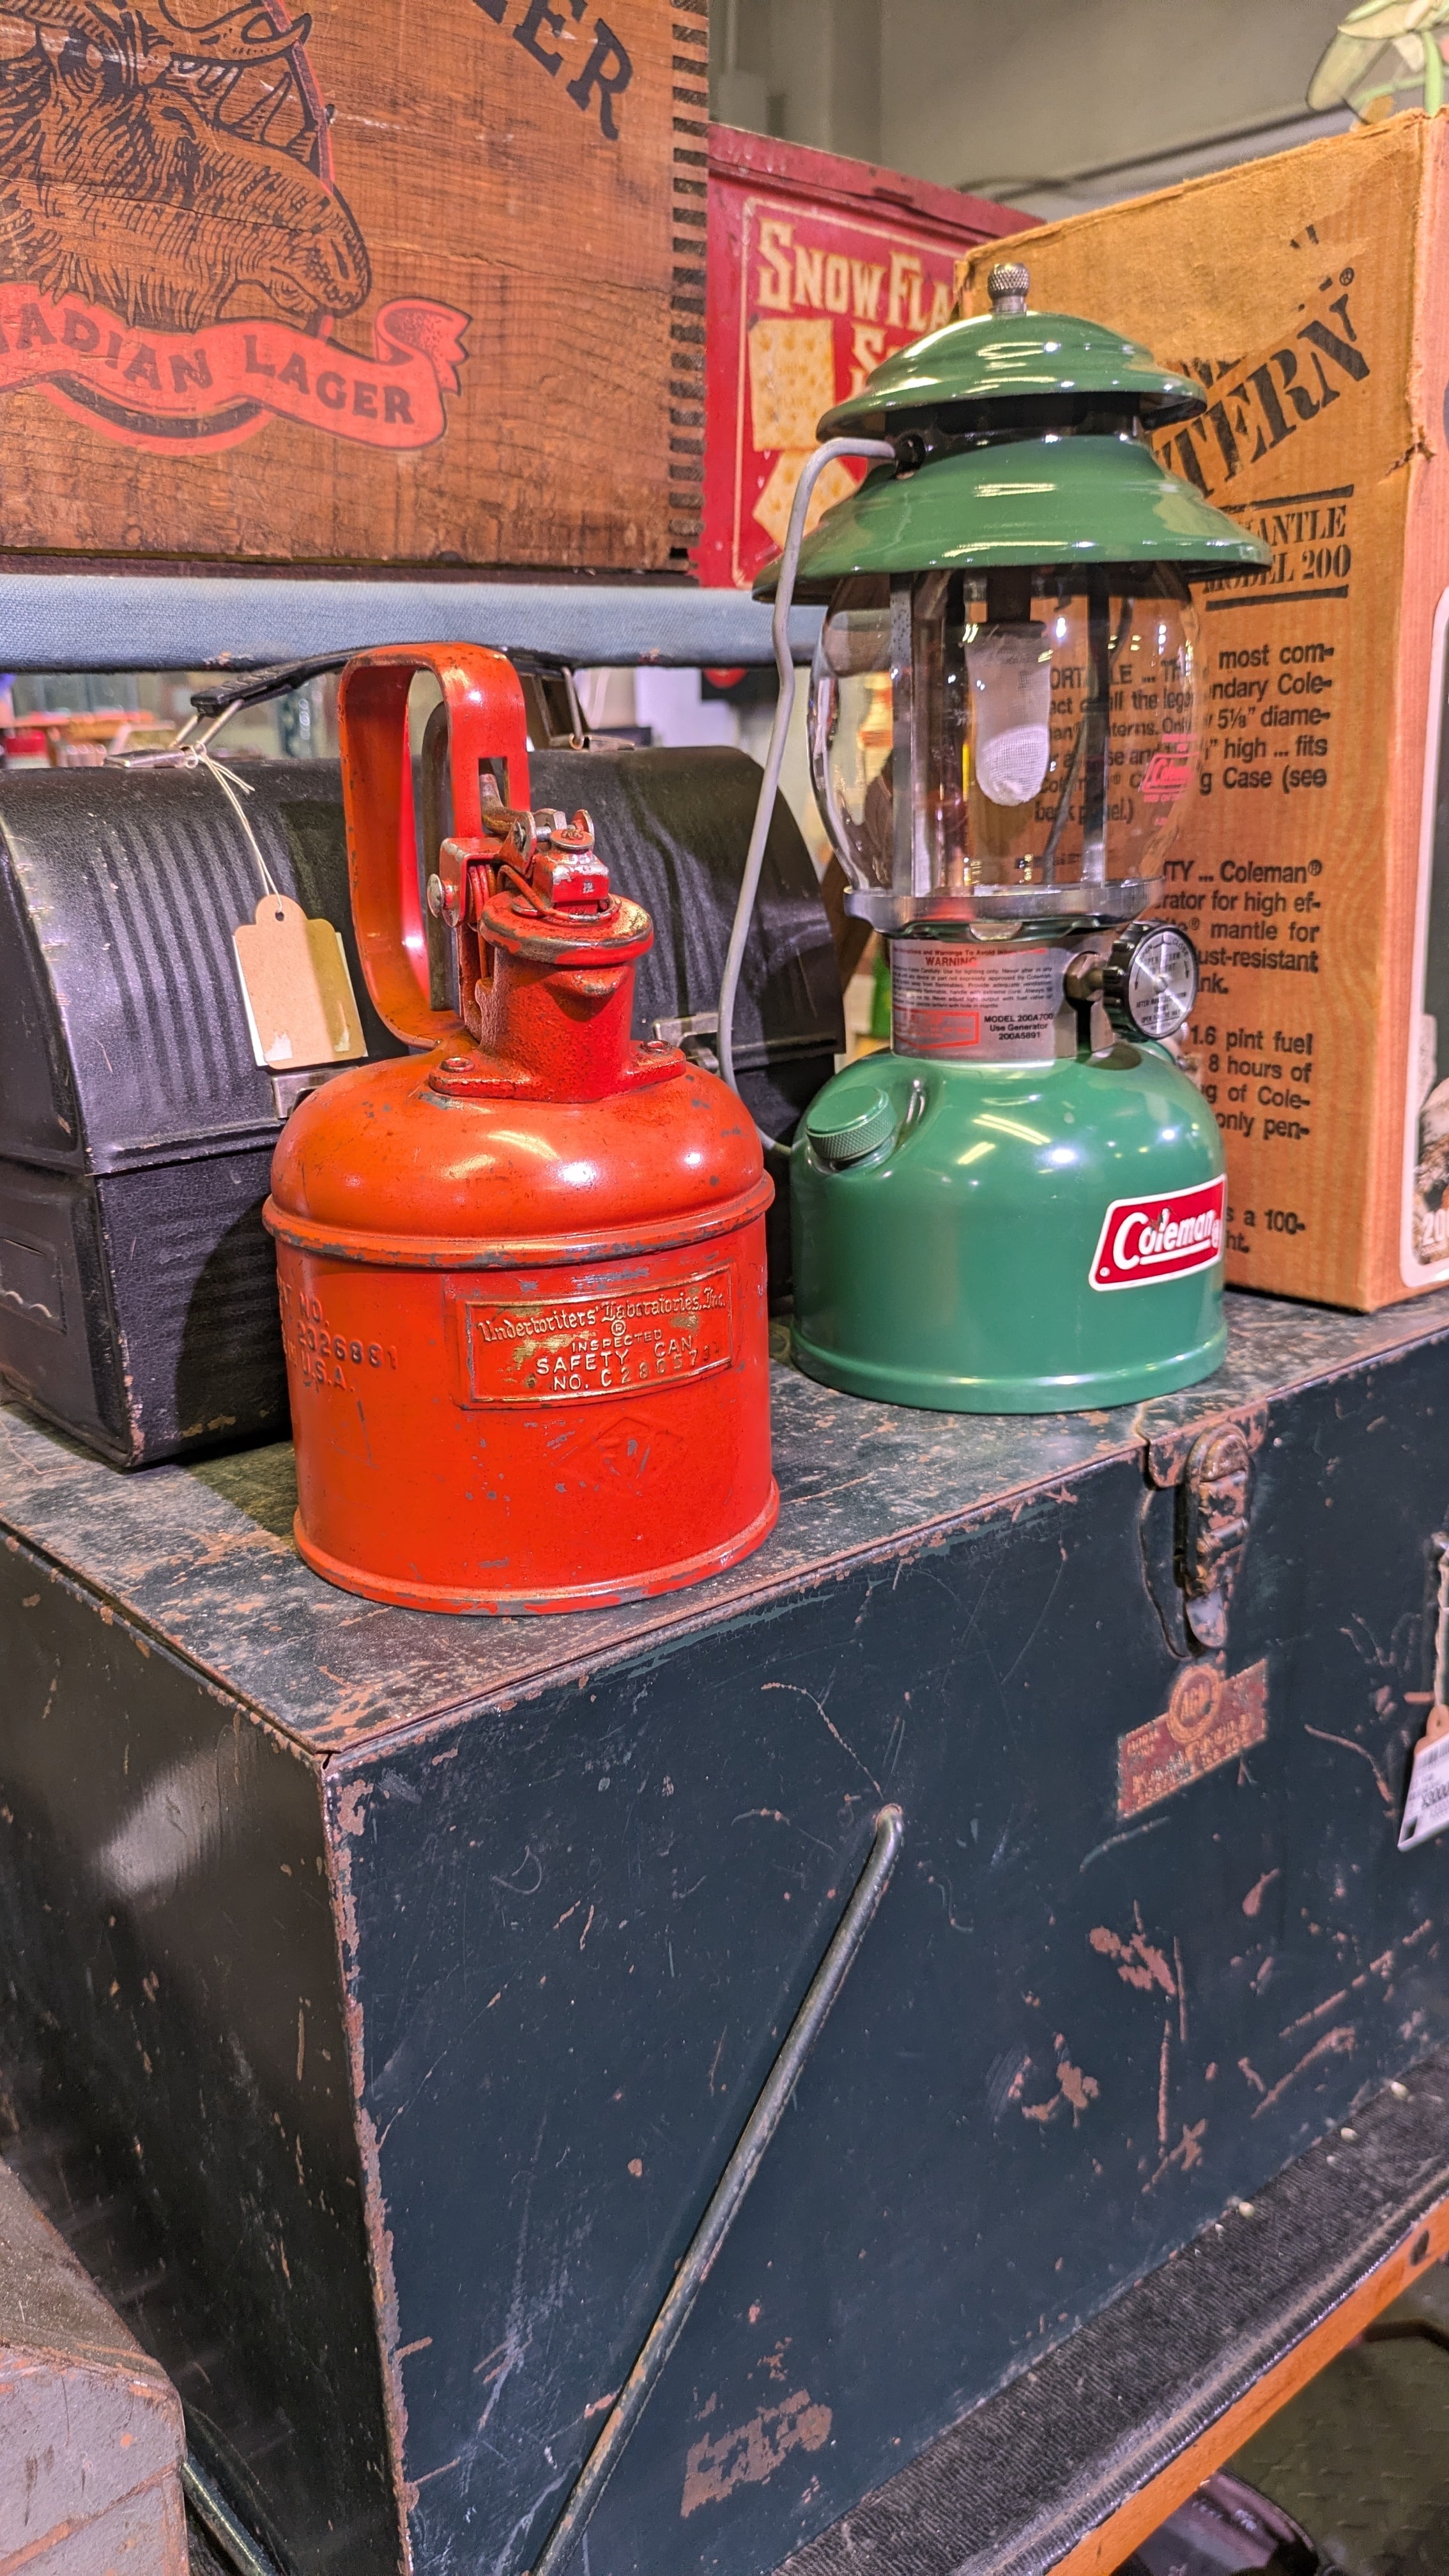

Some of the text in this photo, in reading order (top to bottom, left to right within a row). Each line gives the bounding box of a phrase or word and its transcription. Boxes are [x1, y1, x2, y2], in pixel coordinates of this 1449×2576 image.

[473, 0, 632, 141] ER
[756, 218, 956, 334] SNOW FLA
[0, 301, 415, 425] ADIAN LAGER
[1154, 293, 1371, 498] TERN
[1246, 504, 1346, 547] ANTLE
[1301, 544, 1352, 580] 200
[1218, 644, 1269, 670] most
[1279, 643, 1335, 665] com-
[1278, 671, 1333, 695] Cole-
[1261, 704, 1331, 728] diame-
[1223, 737, 1267, 763] high
[1295, 734, 1328, 757] fits
[1222, 767, 1272, 790] Case
[1282, 764, 1327, 795] (see
[1211, 889, 1238, 911] for
[1243, 892, 1287, 917] high
[1293, 891, 1321, 913] ef-
[1209, 921, 1278, 940] mantle
[1288, 921, 1321, 943] for
[1198, 946, 1319, 974] ust-resistant
[984, 1013, 1054, 1023] MODEL 200A700
[990, 1022, 1048, 1032] Use Generator
[1190, 1024, 1314, 1056] 1.6 pint fuel
[1208, 1053, 1313, 1084] 8 hours of
[1227, 1084, 1248, 1103] of
[1257, 1085, 1310, 1110] Cole-
[1215, 1111, 1310, 1141] only pen-
[1243, 1209, 1256, 1227] a
[1112, 1208, 1218, 1271] Coleman
[535, 1333, 693, 1376] SAFETY CAN
[571, 1329, 663, 1353] INSPECTED
[553, 1375, 590, 1392] NO.
